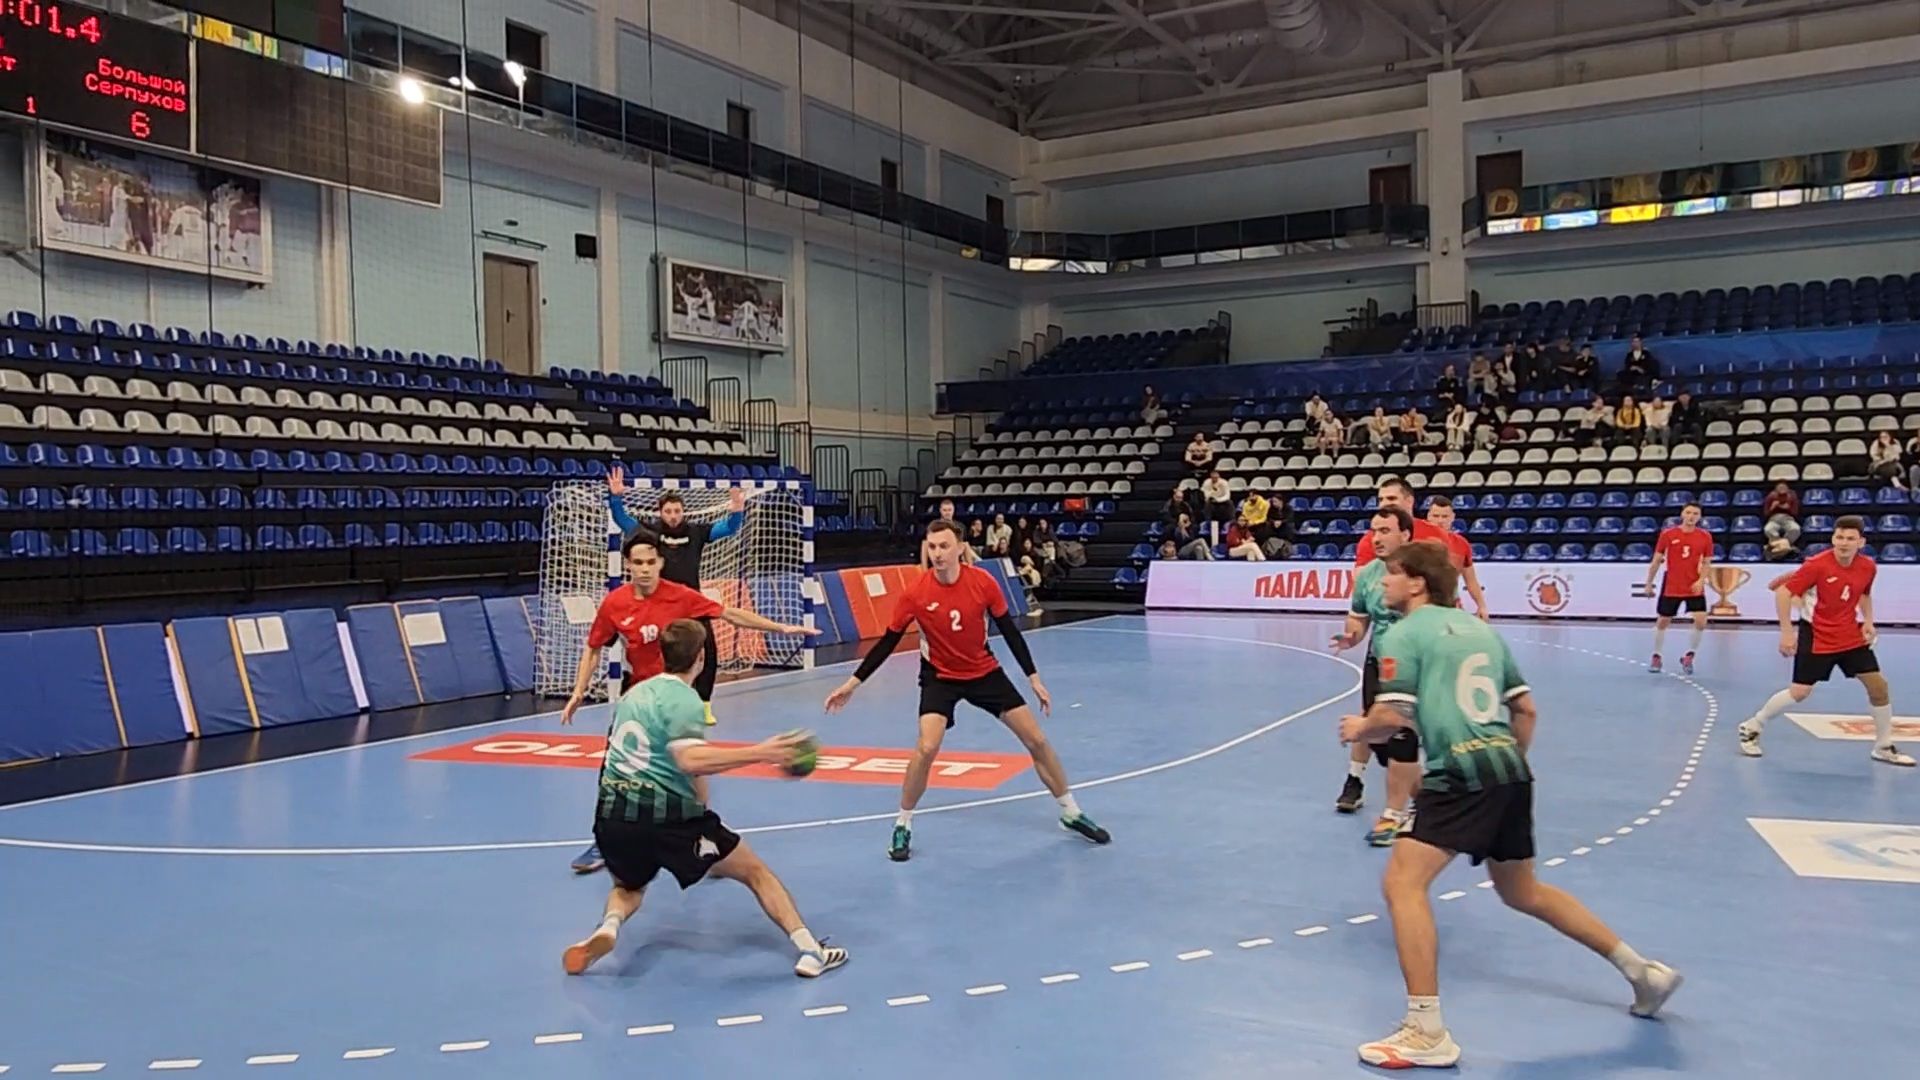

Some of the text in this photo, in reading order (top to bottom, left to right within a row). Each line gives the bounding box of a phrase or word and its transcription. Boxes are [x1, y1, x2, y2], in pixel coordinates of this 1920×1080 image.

[98, 58, 186, 95] Большой
[85, 73, 187, 112] Серпухов
[131, 111, 150, 138] 6
[1254, 569, 1321, 598] ПАПА
[639, 624, 660, 644] 19
[949, 609, 963, 632] 2
[1456, 652, 1500, 724] 6
